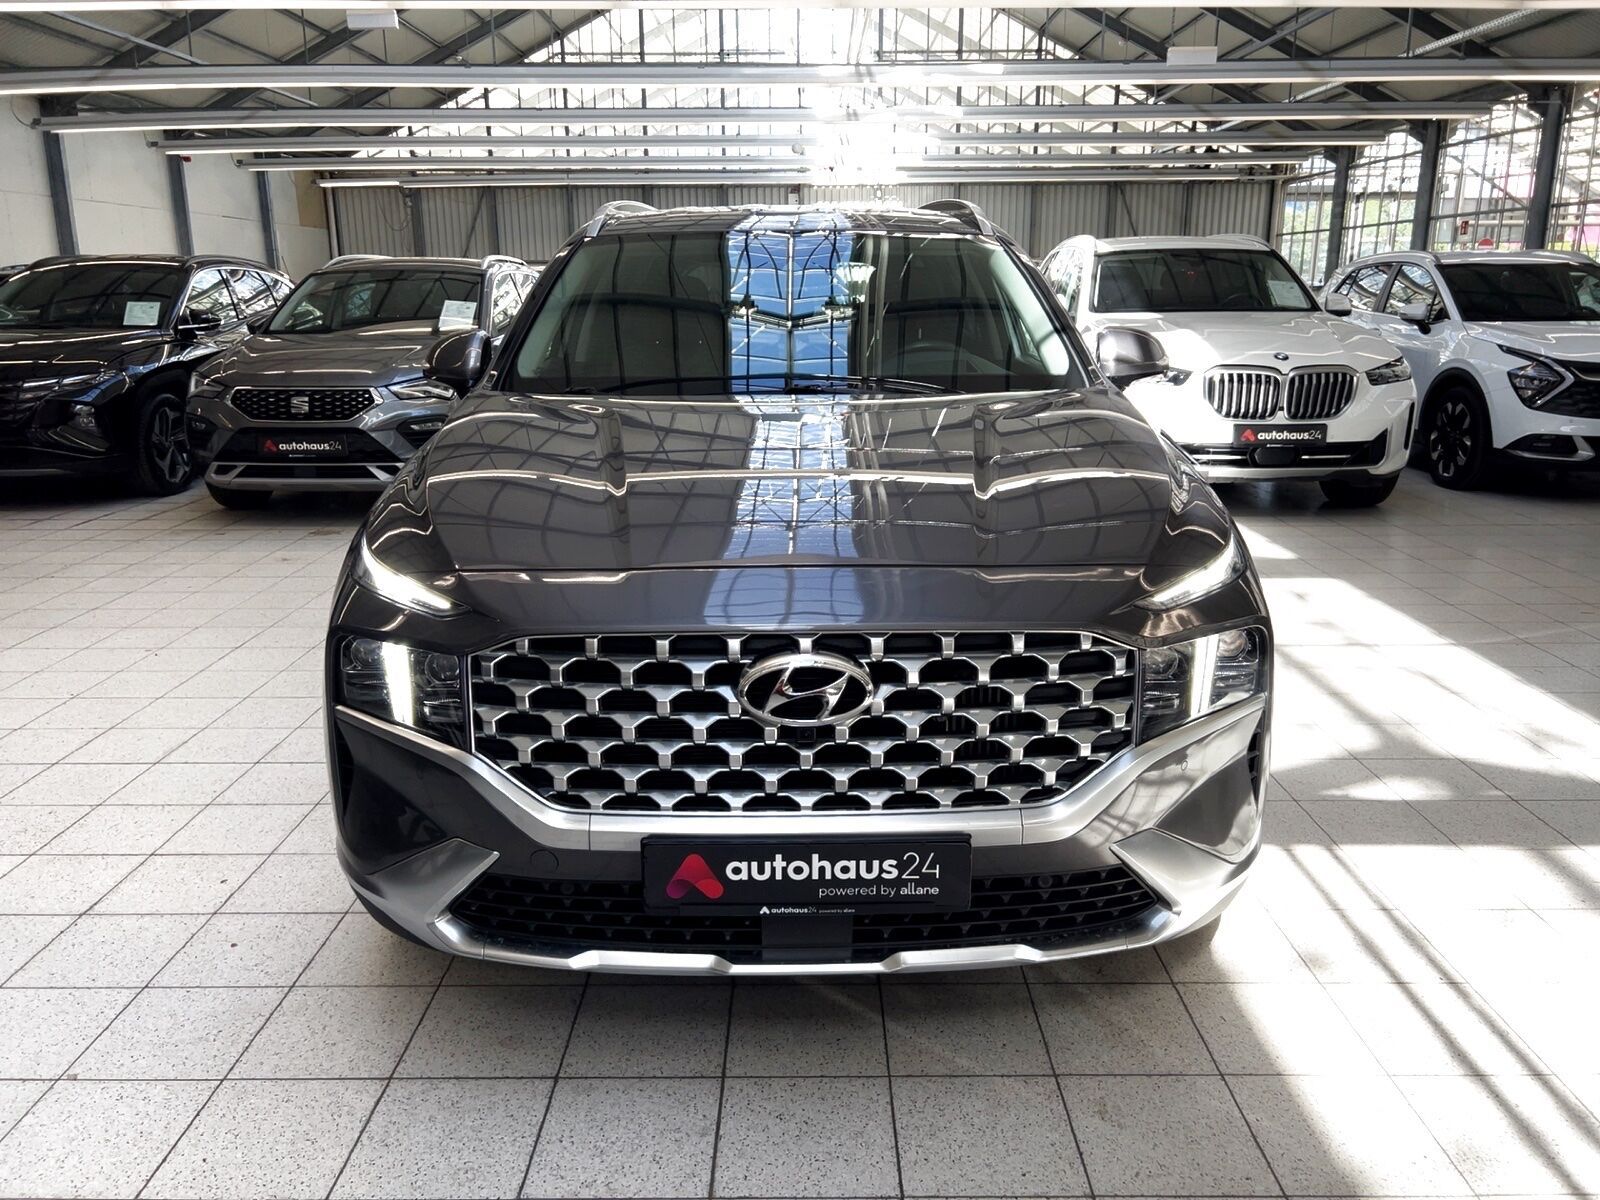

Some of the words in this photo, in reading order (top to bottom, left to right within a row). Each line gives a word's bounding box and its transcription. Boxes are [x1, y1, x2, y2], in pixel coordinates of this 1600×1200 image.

[1257, 430, 1322, 441] autohaus24
[278, 440, 342, 451] autohaus24
[726, 852, 940, 881] autohaus24
[818, 883, 877, 899] powered
[880, 883, 897, 898] by
[900, 882, 940, 896] allane
[771, 906, 817, 914] autohaus24
